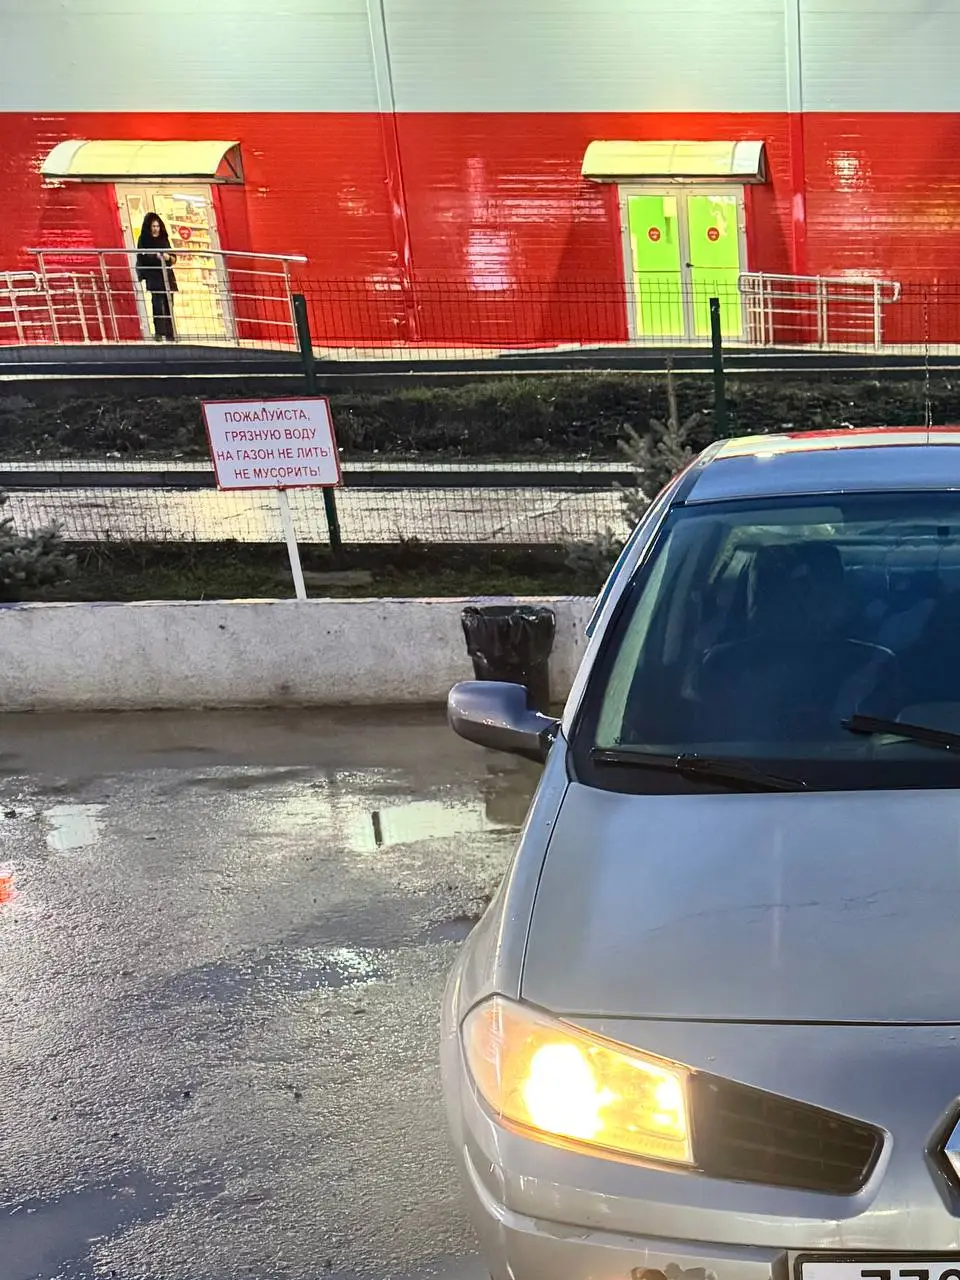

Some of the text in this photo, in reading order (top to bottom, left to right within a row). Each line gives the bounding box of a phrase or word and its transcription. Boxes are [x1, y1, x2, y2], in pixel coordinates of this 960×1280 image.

[224, 407, 311, 423] ПОЖАЛУЙСТА,
[224, 428, 316, 442] ГРЯЗНУЮ ВОДУ
[216, 447, 332, 461] НА ГАЗОН НЕ ЛИТЬ!
[234, 466, 320, 480] НЕ МУСОРИТЬ!
